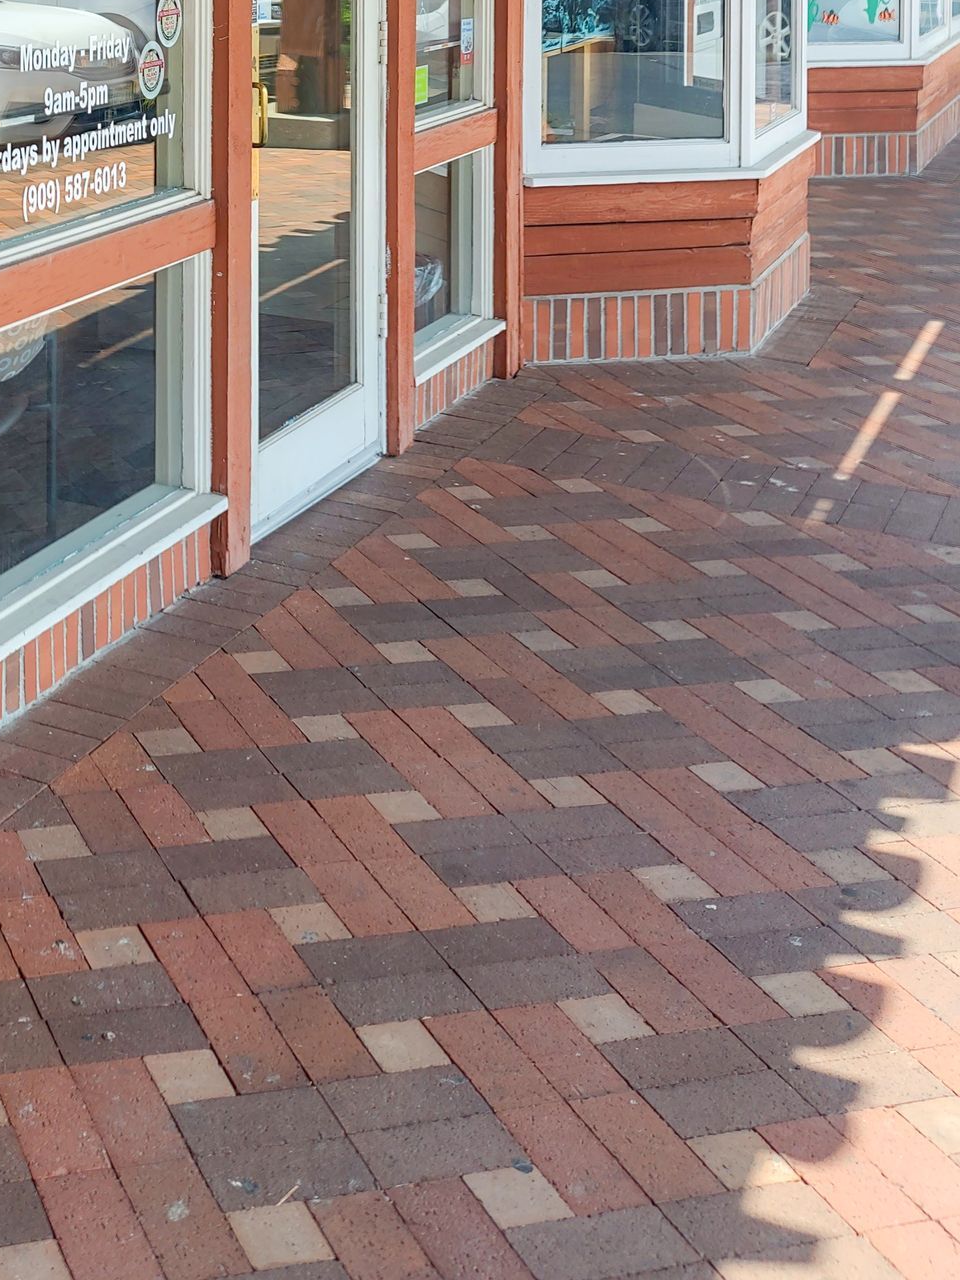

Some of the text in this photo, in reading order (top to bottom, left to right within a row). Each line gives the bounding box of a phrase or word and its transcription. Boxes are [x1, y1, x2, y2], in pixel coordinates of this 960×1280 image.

[20, 40, 77, 73] Monday
[89, 34, 130, 64] Friday
[43, 81, 109, 116] 9am-5pm
[42, 134, 60, 168] by
[63, 114, 148, 161] appointment
[150, 108, 176, 139] only
[22, 161, 127, 223] (909) 587-6013
